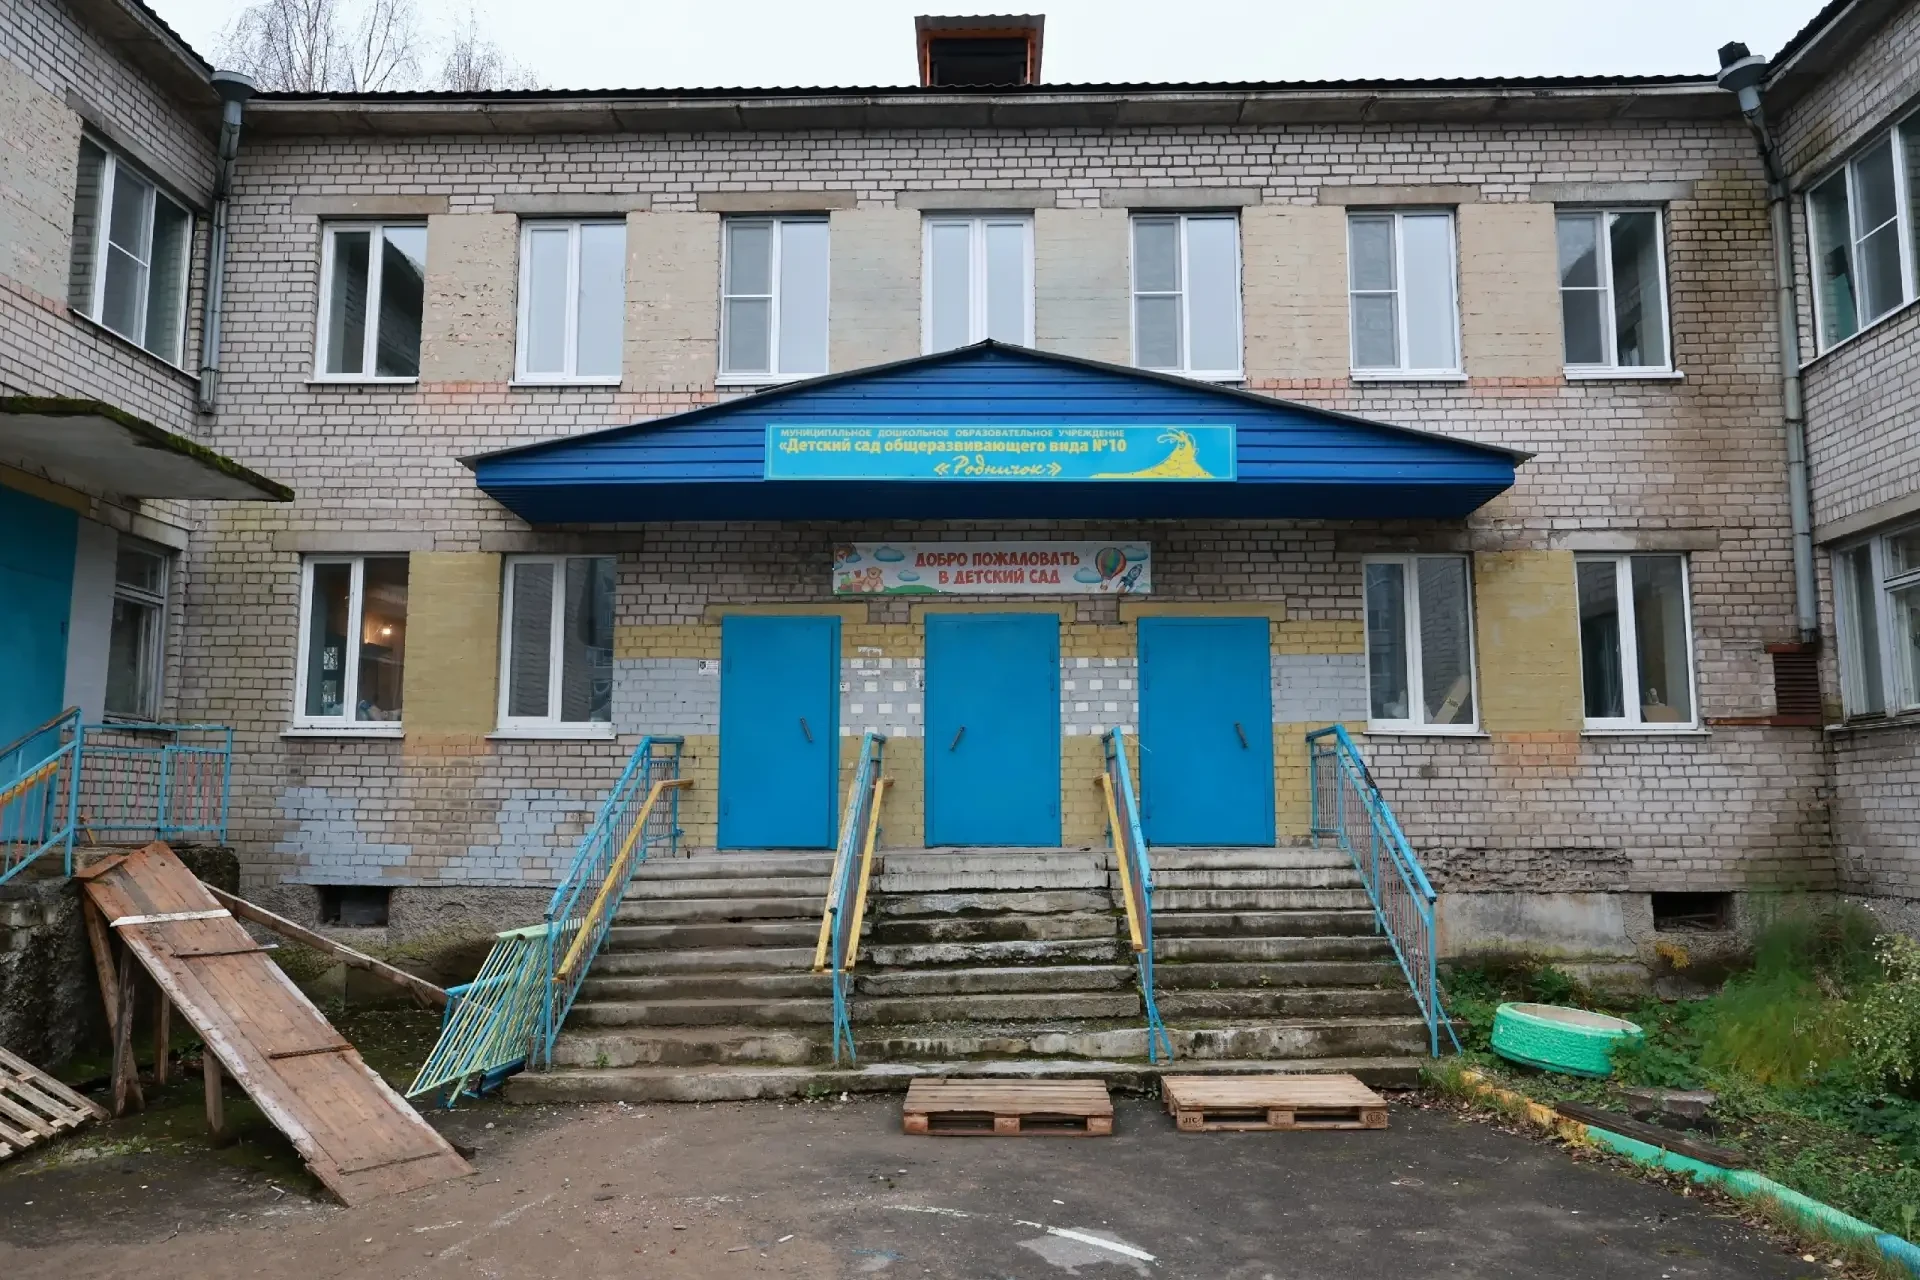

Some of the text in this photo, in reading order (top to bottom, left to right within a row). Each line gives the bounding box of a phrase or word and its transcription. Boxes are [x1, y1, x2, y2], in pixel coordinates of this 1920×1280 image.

[780, 428, 1125, 438] МУНИЦИПАЛЬНОЕ ДОШКОЛЬНОЕ ОБРАЗОВАТЕЛЬНОЕ УЧРЕЖДЕНИЕ
[779, 438, 1127, 454] «Детский сад общеразвивающего вида №10
[933, 454, 1062, 476] «Родничок»
[914, 551, 1080, 567] ДОБРО ПОЖАЛОВАТЬ
[938, 568, 1061, 584] В ДЕТСКИЙ САД
